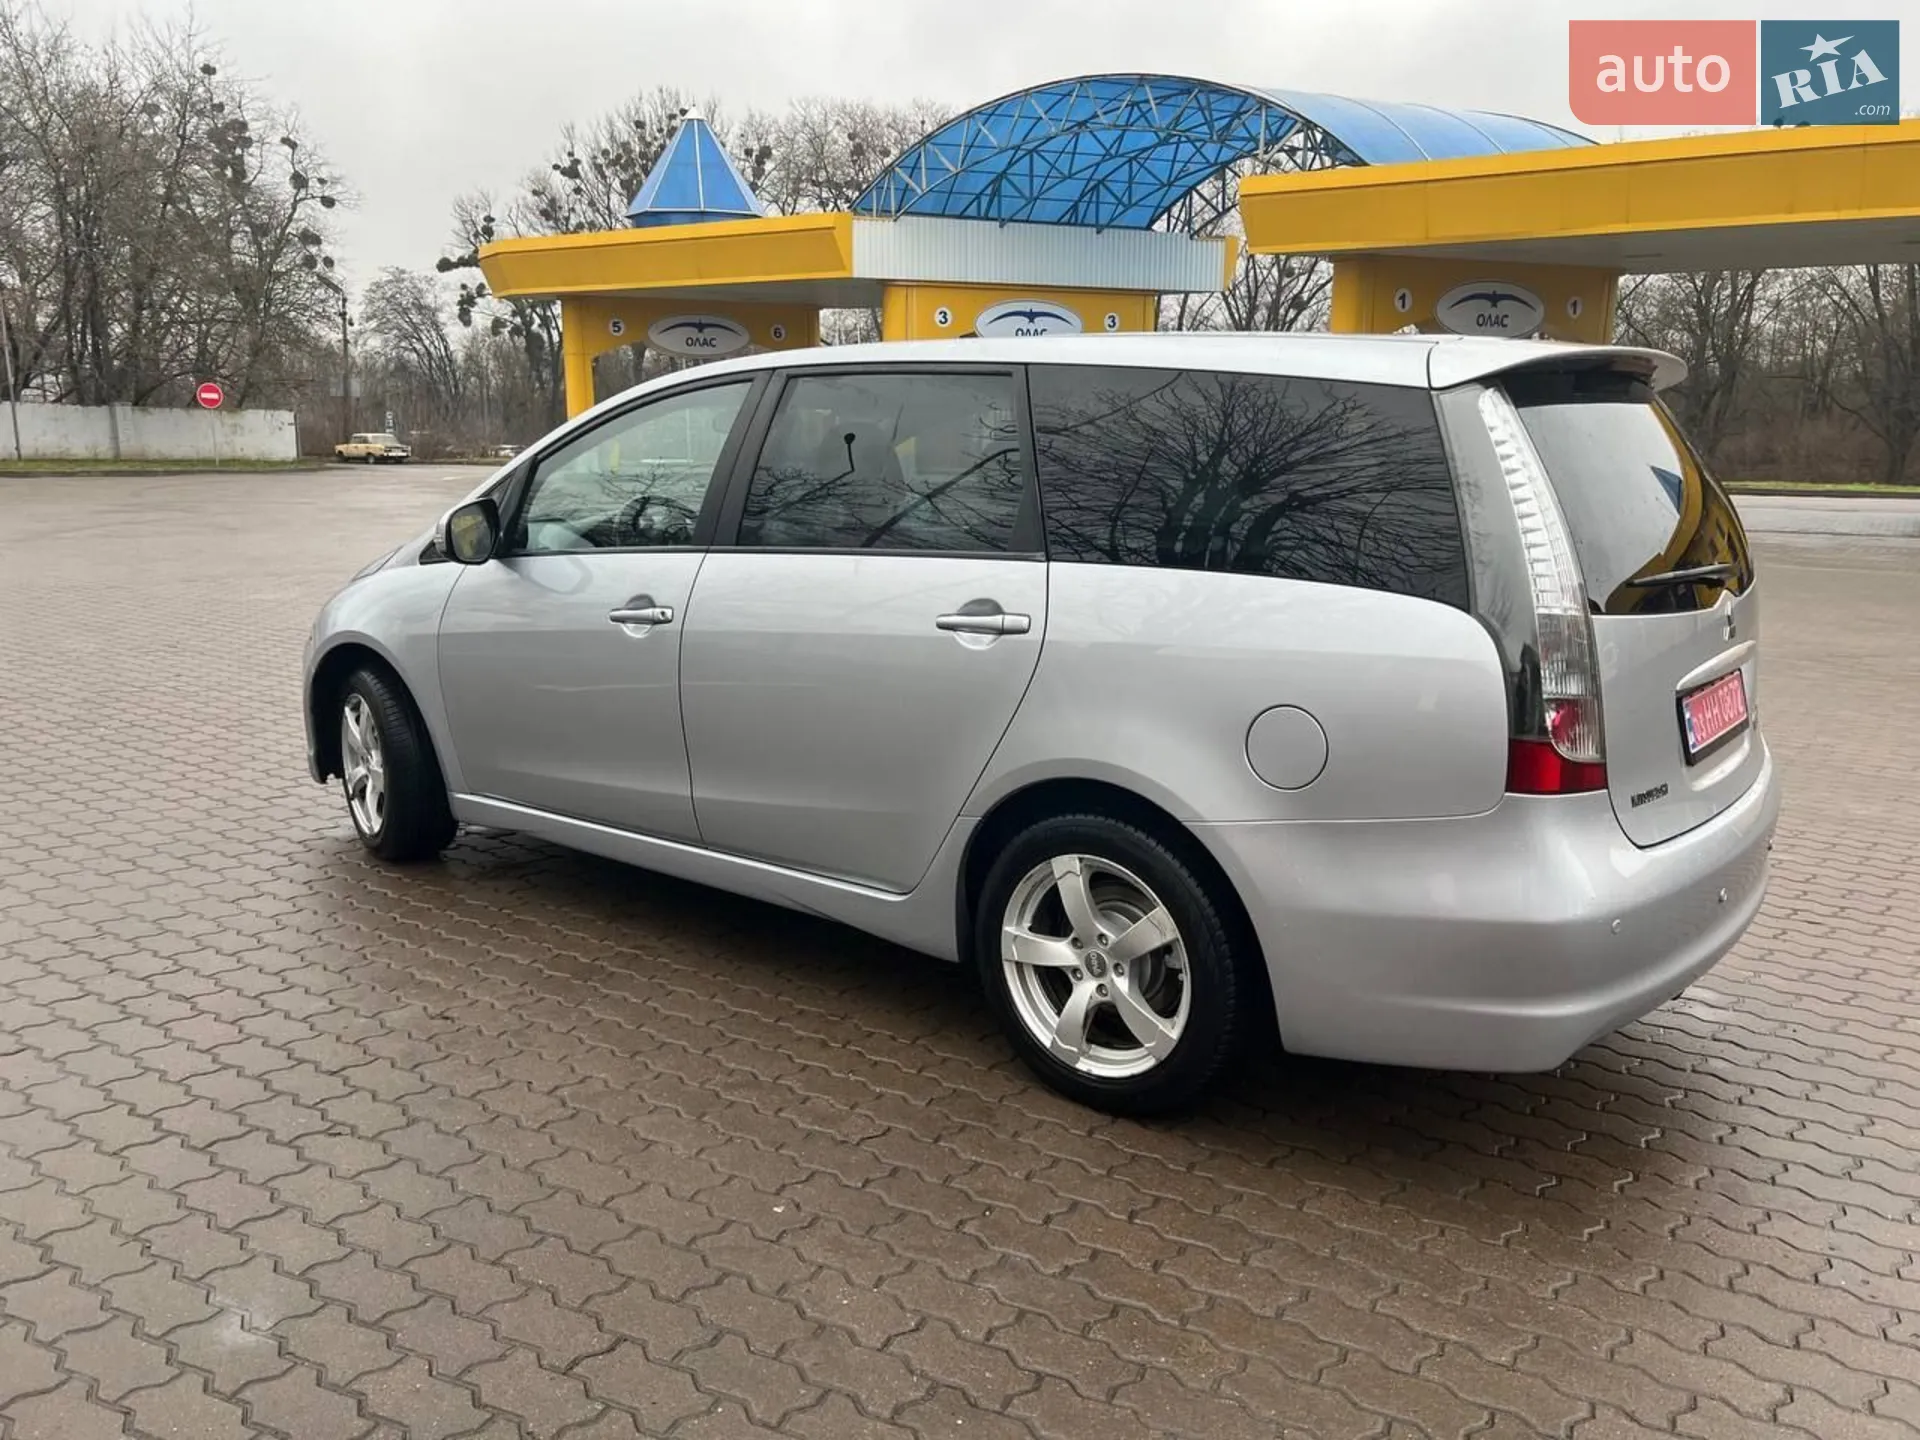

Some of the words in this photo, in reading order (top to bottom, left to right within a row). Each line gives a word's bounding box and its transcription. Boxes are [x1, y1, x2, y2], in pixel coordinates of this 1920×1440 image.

[1398, 292, 1406, 308] 1
[938, 311, 948, 325] 3
[1107, 315, 1117, 328] 3
[1476, 313, 1509, 328] ОЛАС
[612, 321, 622, 333] 5
[773, 327, 782, 338] 6
[685, 337, 717, 348] ОЛАС
